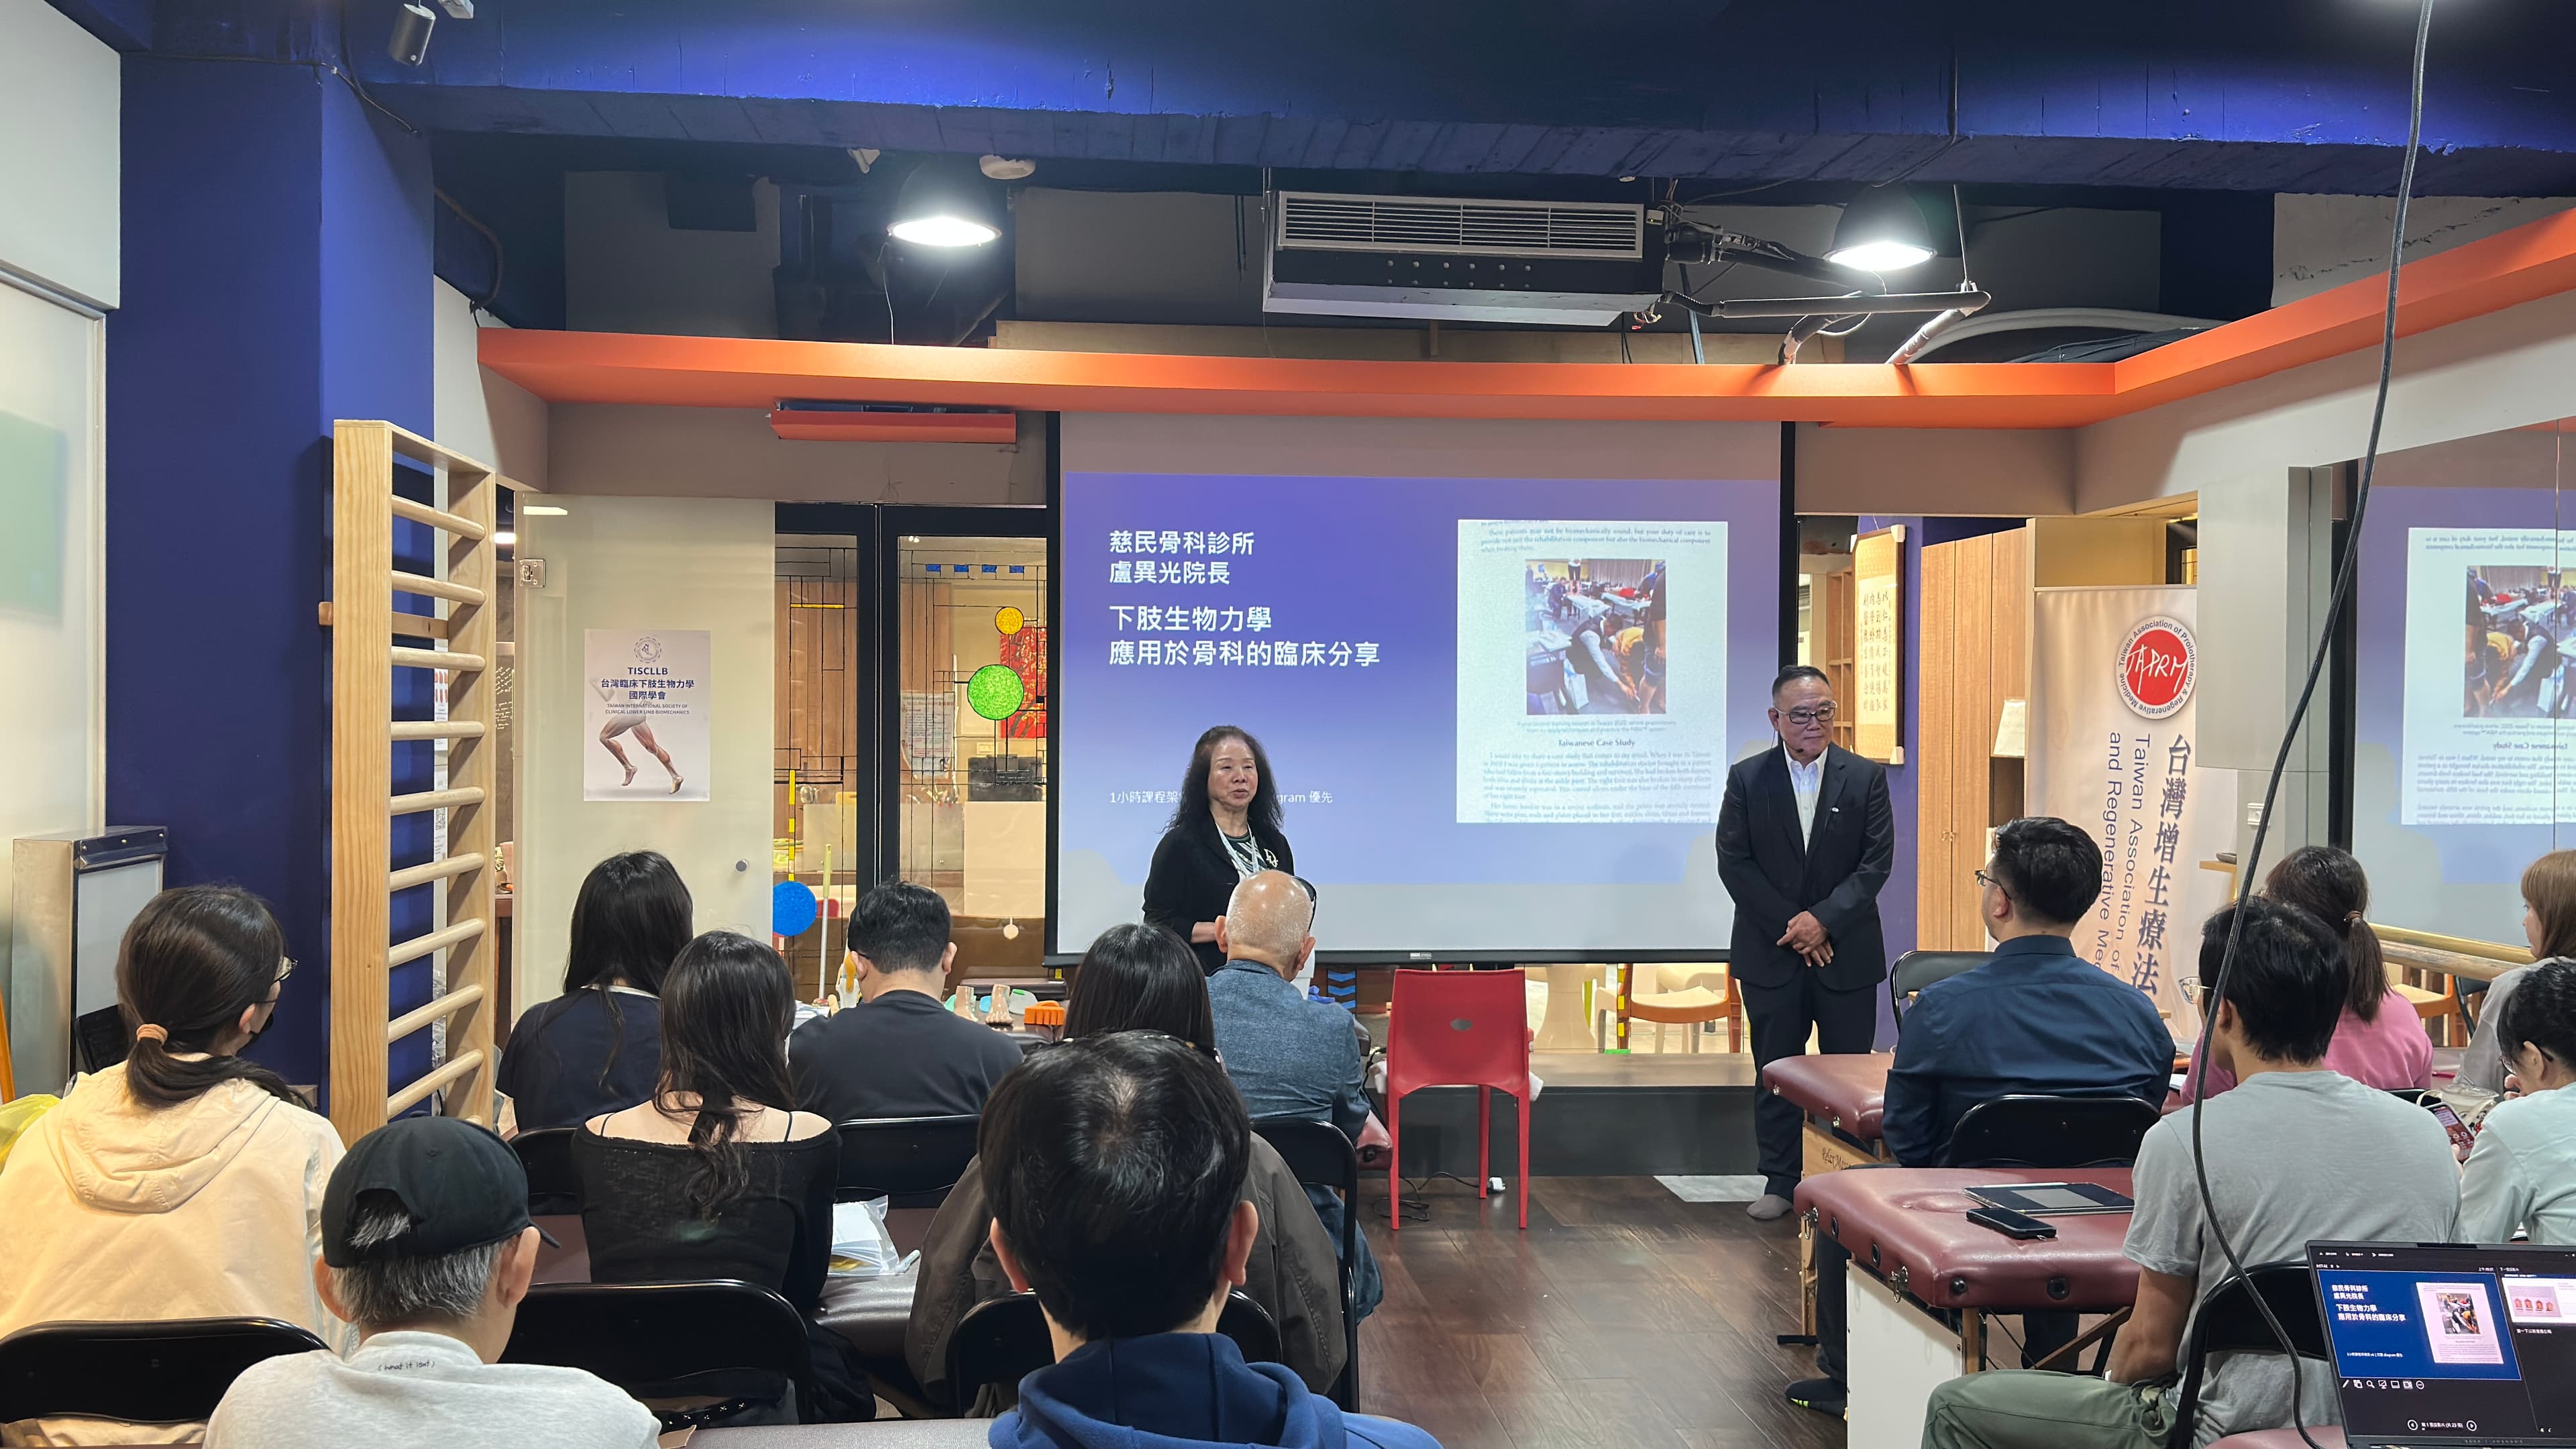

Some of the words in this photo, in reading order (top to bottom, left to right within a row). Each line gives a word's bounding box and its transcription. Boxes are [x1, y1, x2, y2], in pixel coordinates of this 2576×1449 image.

[1110, 530, 1254, 555] 慈民骨科診所
[1110, 561, 1230, 585] 盧異光院長
[1110, 605, 1272, 633] 下肢生物力學
[2133, 619, 2173, 639] Association
[2174, 627, 2182, 635] of
[1110, 639, 1380, 667] 應用於骨科的臨床分享
[2118, 638, 2134, 666] Taiwan
[2180, 632, 2196, 688] Prolotherapy
[601, 678, 694, 688] 台灣臨床下肢生物力學
[628, 667, 668, 675] TISCLLB
[629, 690, 666, 700] 國際學會
[2119, 673, 2139, 708] Medicine
[2139, 696, 2184, 714] Regenerative
[1615, 739, 1635, 747] Study
[2108, 732, 2123, 771] and
[2131, 733, 2151, 810] Taiwan
[1110, 790, 1182, 804] 1小時課程架
[1309, 790, 1333, 804] 優先
[2100, 780, 2123, 920] Regenerative
[2132, 733, 2191, 996] 台灣增生療法
[2115, 818, 2143, 940] Association
[2110, 949, 2120, 971] of
